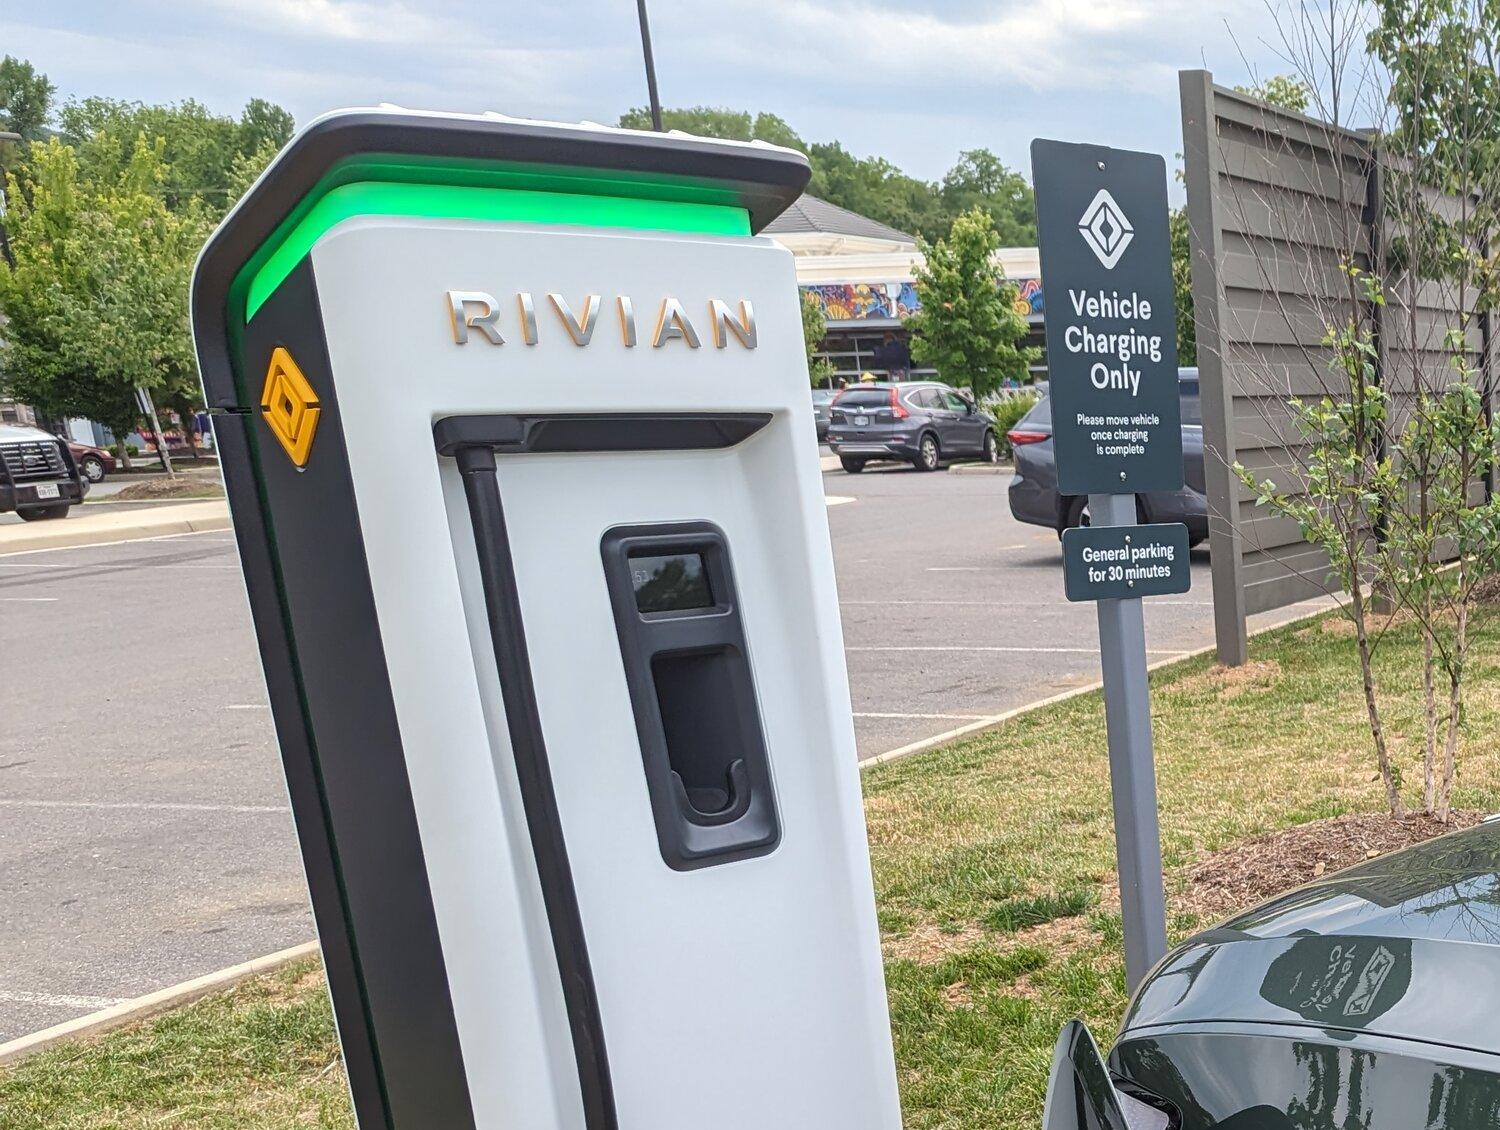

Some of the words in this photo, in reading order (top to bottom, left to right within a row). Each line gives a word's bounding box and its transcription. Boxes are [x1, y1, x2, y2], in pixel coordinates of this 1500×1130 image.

[1068, 289, 1152, 320] Vehicle
[446, 290, 758, 349] RIVIAN
[1064, 325, 1162, 363] Charging
[1090, 362, 1141, 397] Only
[1076, 413, 1105, 426] Please
[1106, 416, 1130, 425] move
[1130, 413, 1160, 426] vehicle
[1090, 431, 1113, 440] once
[1113, 428, 1149, 442] charging
[1096, 444, 1104, 455] is
[1104, 443, 1145, 458] complete
[1082, 545, 1130, 562] General
[1131, 543, 1175, 563] parking
[1088, 567, 1107, 582] for
[1108, 566, 1123, 581] 30
[1125, 564, 1171, 580] minutes
